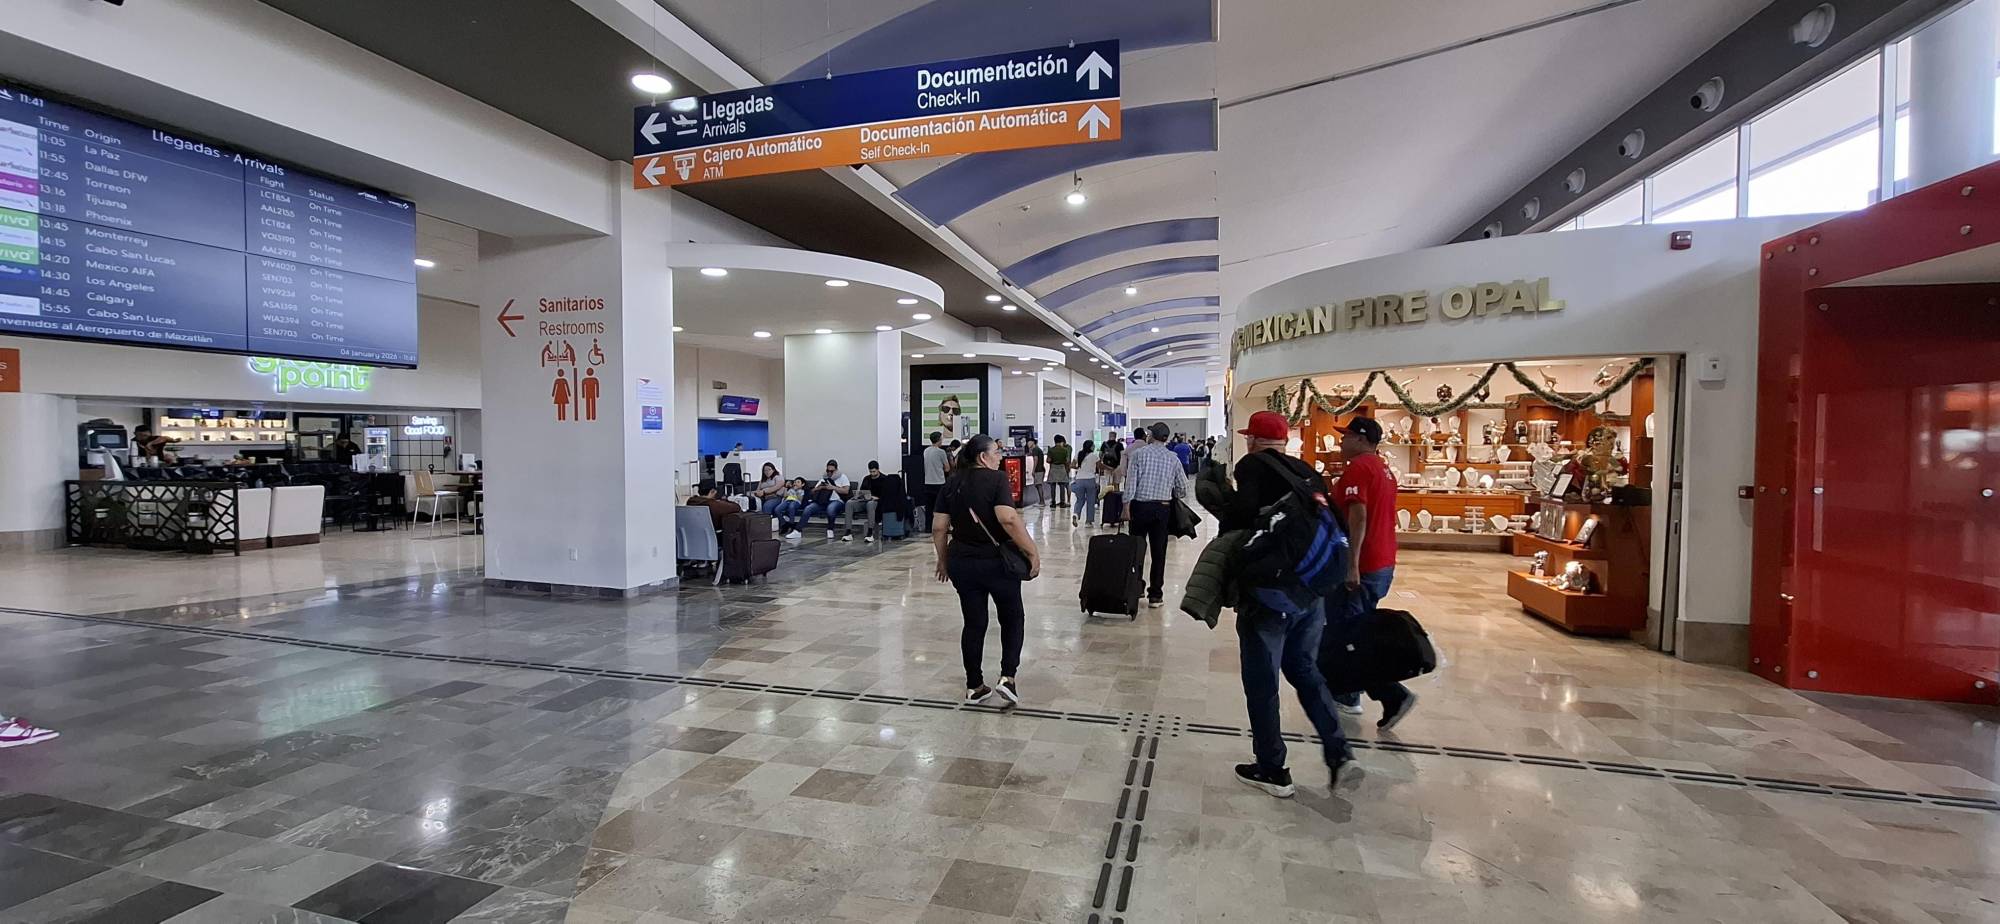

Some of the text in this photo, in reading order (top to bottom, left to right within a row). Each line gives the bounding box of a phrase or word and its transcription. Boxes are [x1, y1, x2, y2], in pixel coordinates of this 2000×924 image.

[917, 54, 1068, 90] Documentación
[20, 93, 44, 108] 11:41
[917, 87, 980, 109] Check-In
[702, 95, 774, 122] Llegadas
[38, 115, 70, 131] Time
[702, 119, 746, 139] Arrivals
[860, 108, 1068, 144] Documentación Automática
[39, 133, 66, 147] 11:05
[84, 128, 121, 145] Origin
[39, 150, 66, 164] 11:55
[84, 145, 121, 161] La Paz
[152, 129, 221, 158] Llegadas
[233, 153, 285, 176] Arrivals
[703, 136, 822, 165] Cajero Automático
[860, 141, 930, 160] Self Check-In
[40, 167, 69, 181] 12:45
[84, 161, 148, 183] Dallas DFW
[703, 166, 724, 180] ATM
[85, 177, 131, 195] Torreon
[260, 176, 285, 189] Flight
[85, 193, 128, 210] Tijuana
[308, 188, 335, 202] Status
[308, 202, 322, 211] On
[40, 218, 69, 232] 13:45
[85, 210, 133, 226] Phoenix
[309, 215, 322, 223] On
[85, 227, 148, 248] Monterrey
[309, 228, 322, 237] On
[40, 235, 66, 248] 14:15
[309, 241, 322, 249] On
[40, 252, 70, 265] 14:20
[85, 243, 176, 266] Cabo San Lucas
[310, 254, 322, 262] On
[40, 269, 71, 281] 14:30
[85, 259, 155, 277] Mexico AIFA
[310, 268, 322, 276] On
[41, 285, 71, 297] 14:45
[85, 276, 155, 293] Los Angeles
[310, 280, 323, 288] On
[86, 292, 135, 307] Calgary
[310, 294, 323, 302] On
[538, 295, 604, 313] Sanitarios
[41, 302, 71, 314] 15:55
[311, 307, 323, 315] On
[1245, 304, 1334, 348] MEXICAN
[1348, 291, 1429, 329] FIRE
[1442, 277, 1565, 319] OPAL
[87, 308, 177, 325] Cabo San Lucas
[311, 319, 324, 328] On
[61, 322, 73, 331] al
[75, 323, 145, 336] Aeropuerto
[147, 330, 162, 339] de
[165, 332, 213, 343] Mazatlán
[311, 332, 324, 340] On
[539, 320, 605, 337] Restrooms
[351, 350, 380, 360] January
[276, 361, 370, 394] point
[423, 425, 446, 435] FOOD
